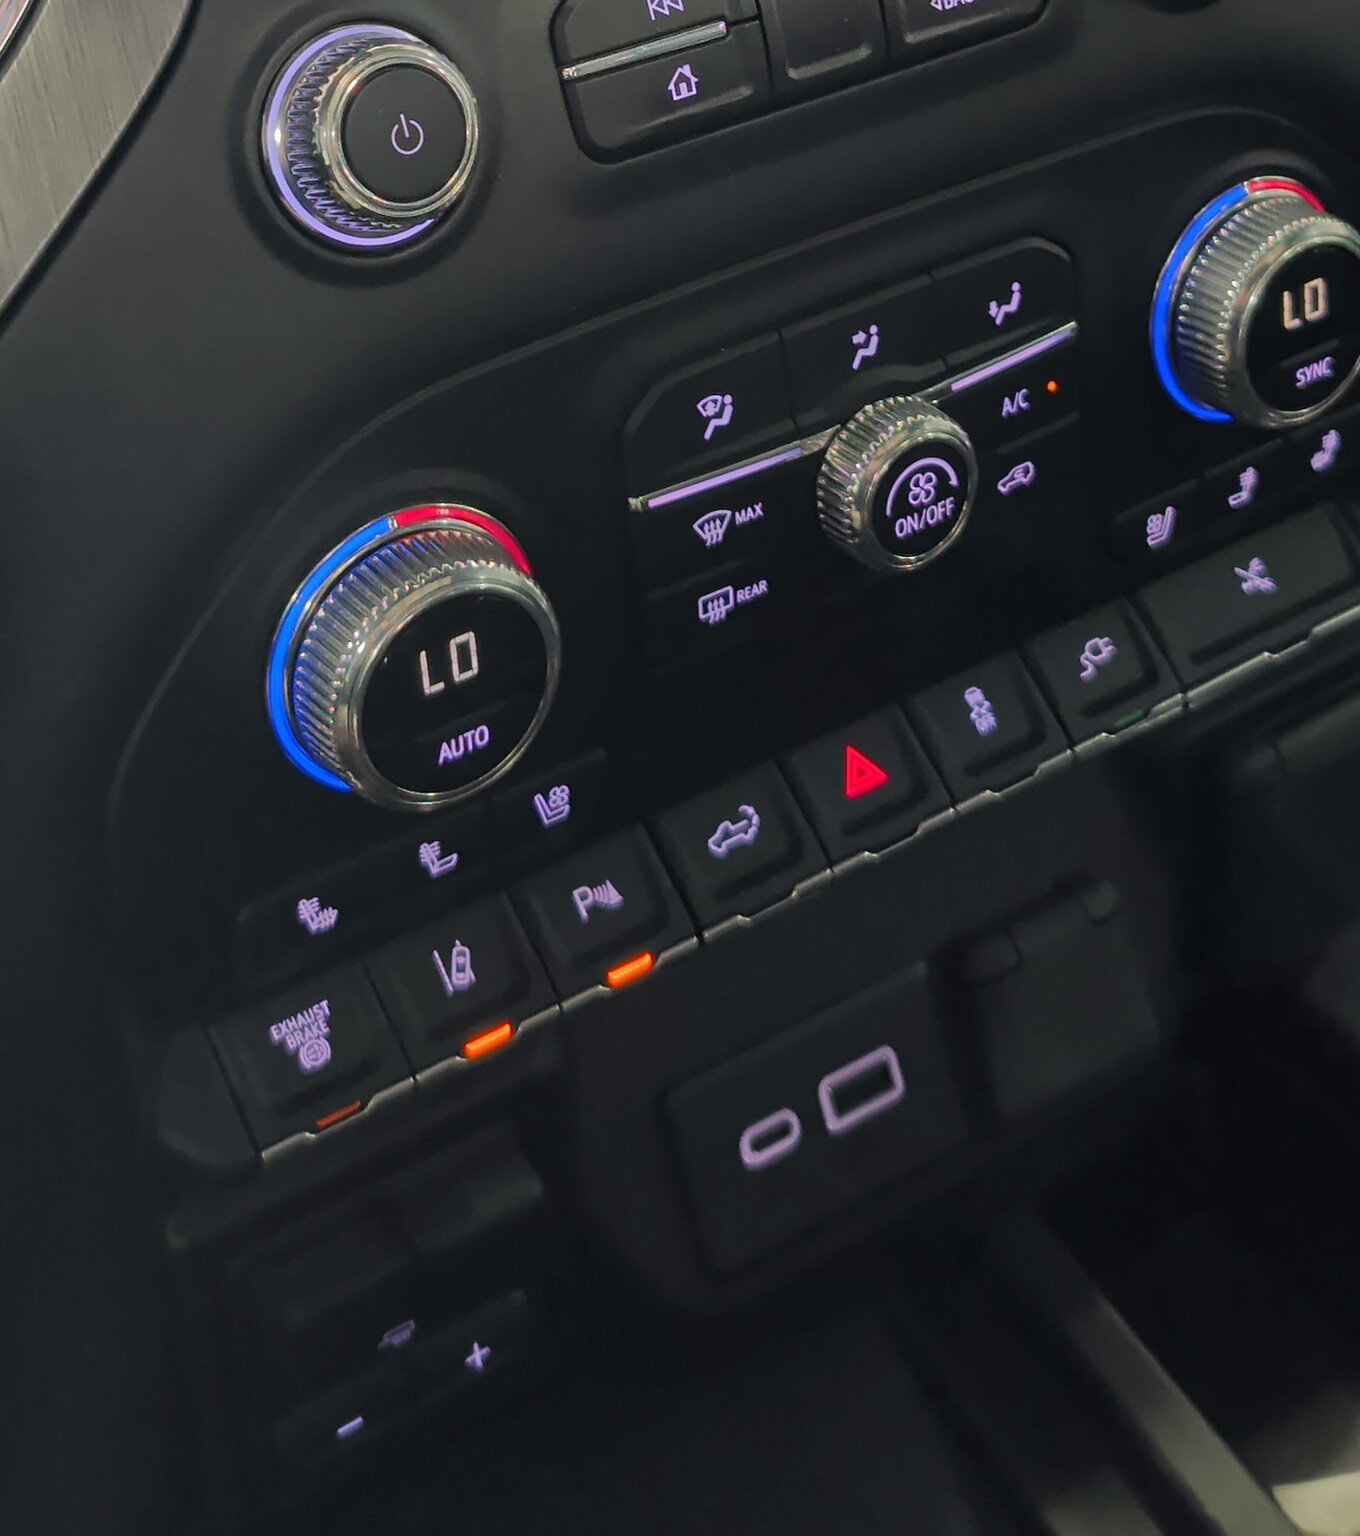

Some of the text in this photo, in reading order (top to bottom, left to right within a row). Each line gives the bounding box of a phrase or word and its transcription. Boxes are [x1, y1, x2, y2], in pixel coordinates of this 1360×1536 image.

[1295, 356, 1335, 389] SYNC
[1001, 388, 1031, 418] A/C
[734, 502, 764, 526] MAX
[894, 496, 957, 539] ON/OFF
[736, 579, 768, 604] REAR
[438, 724, 490, 766] AUTO
[268, 999, 331, 1041] EXHAUST
[285, 1019, 331, 1050] BRAKE
